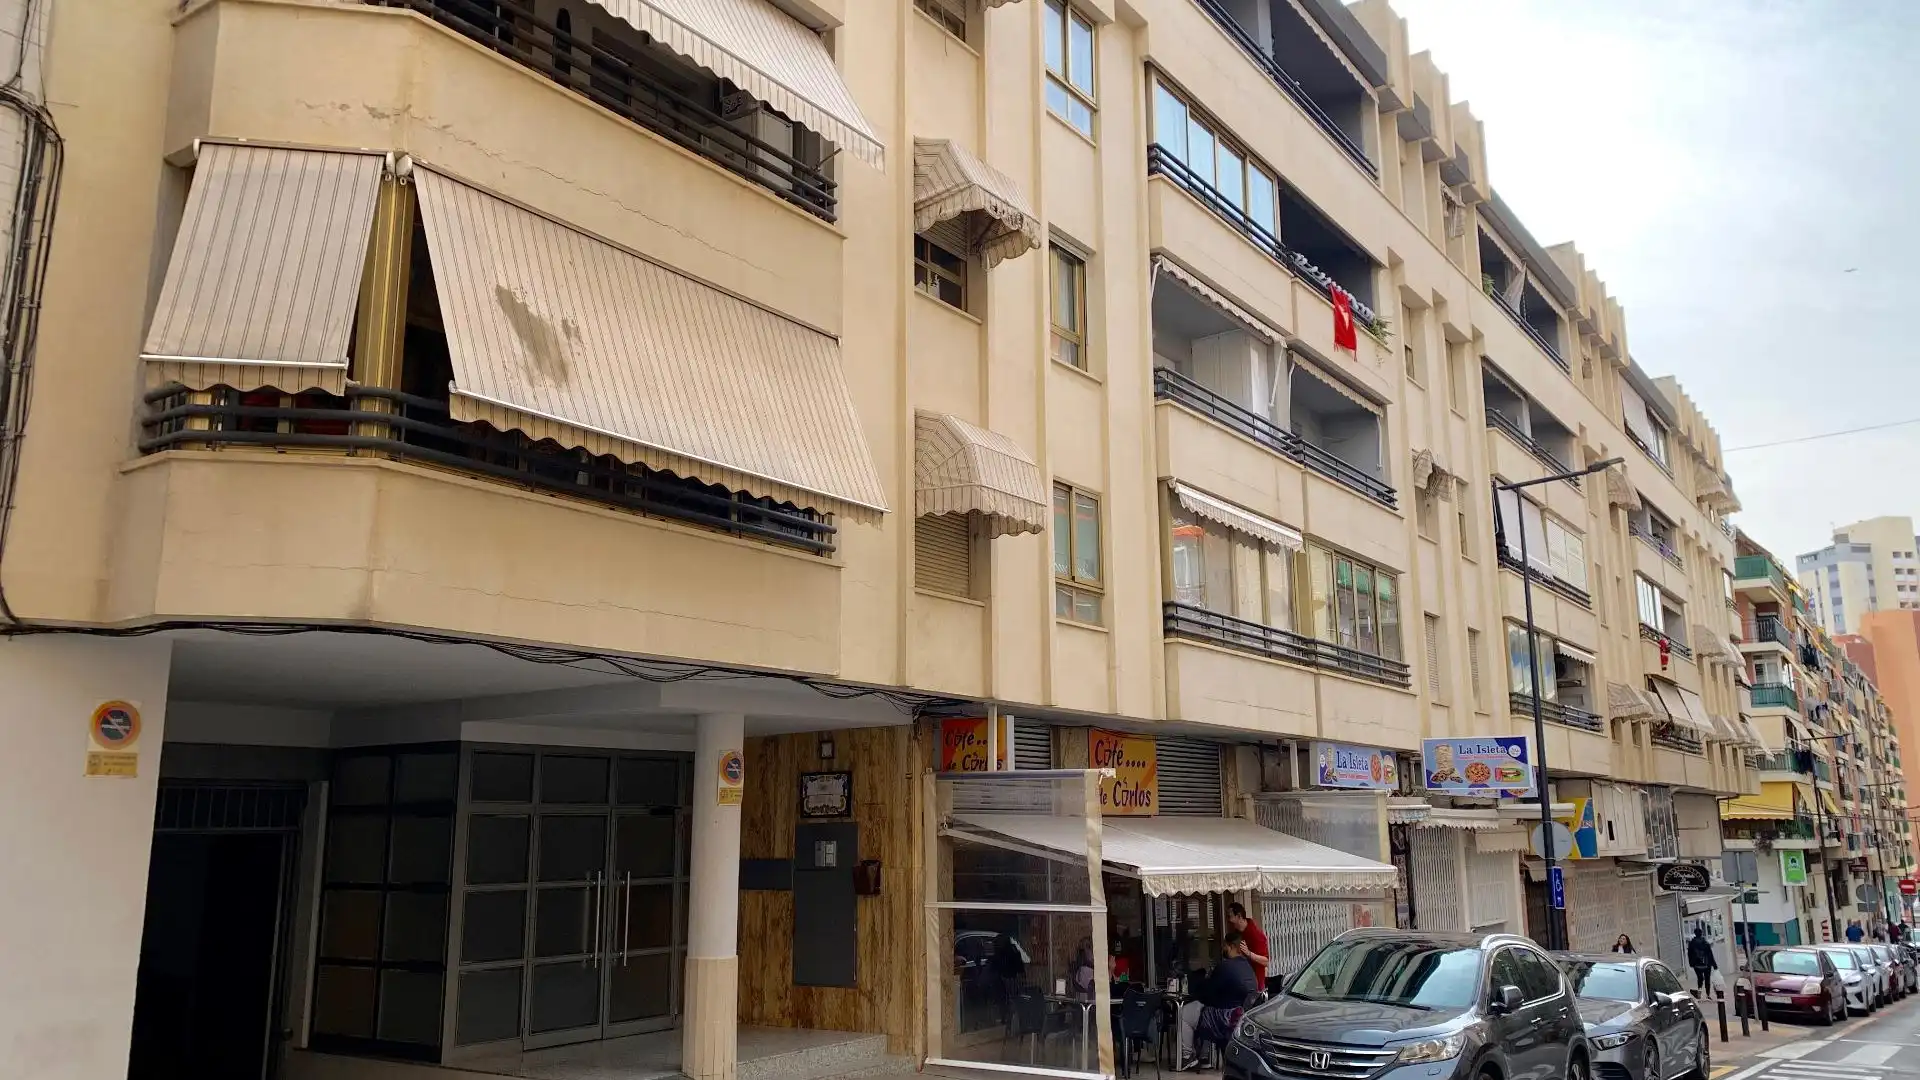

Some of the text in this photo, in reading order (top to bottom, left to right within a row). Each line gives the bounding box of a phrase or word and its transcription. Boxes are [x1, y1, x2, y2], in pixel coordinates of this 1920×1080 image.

[1459, 745, 1473, 755] La
[1476, 744, 1506, 754] Isleta
[1336, 751, 1347, 769] La
[1349, 752, 1369, 771] Isleta
[1112, 778, 1152, 808] Carlos
